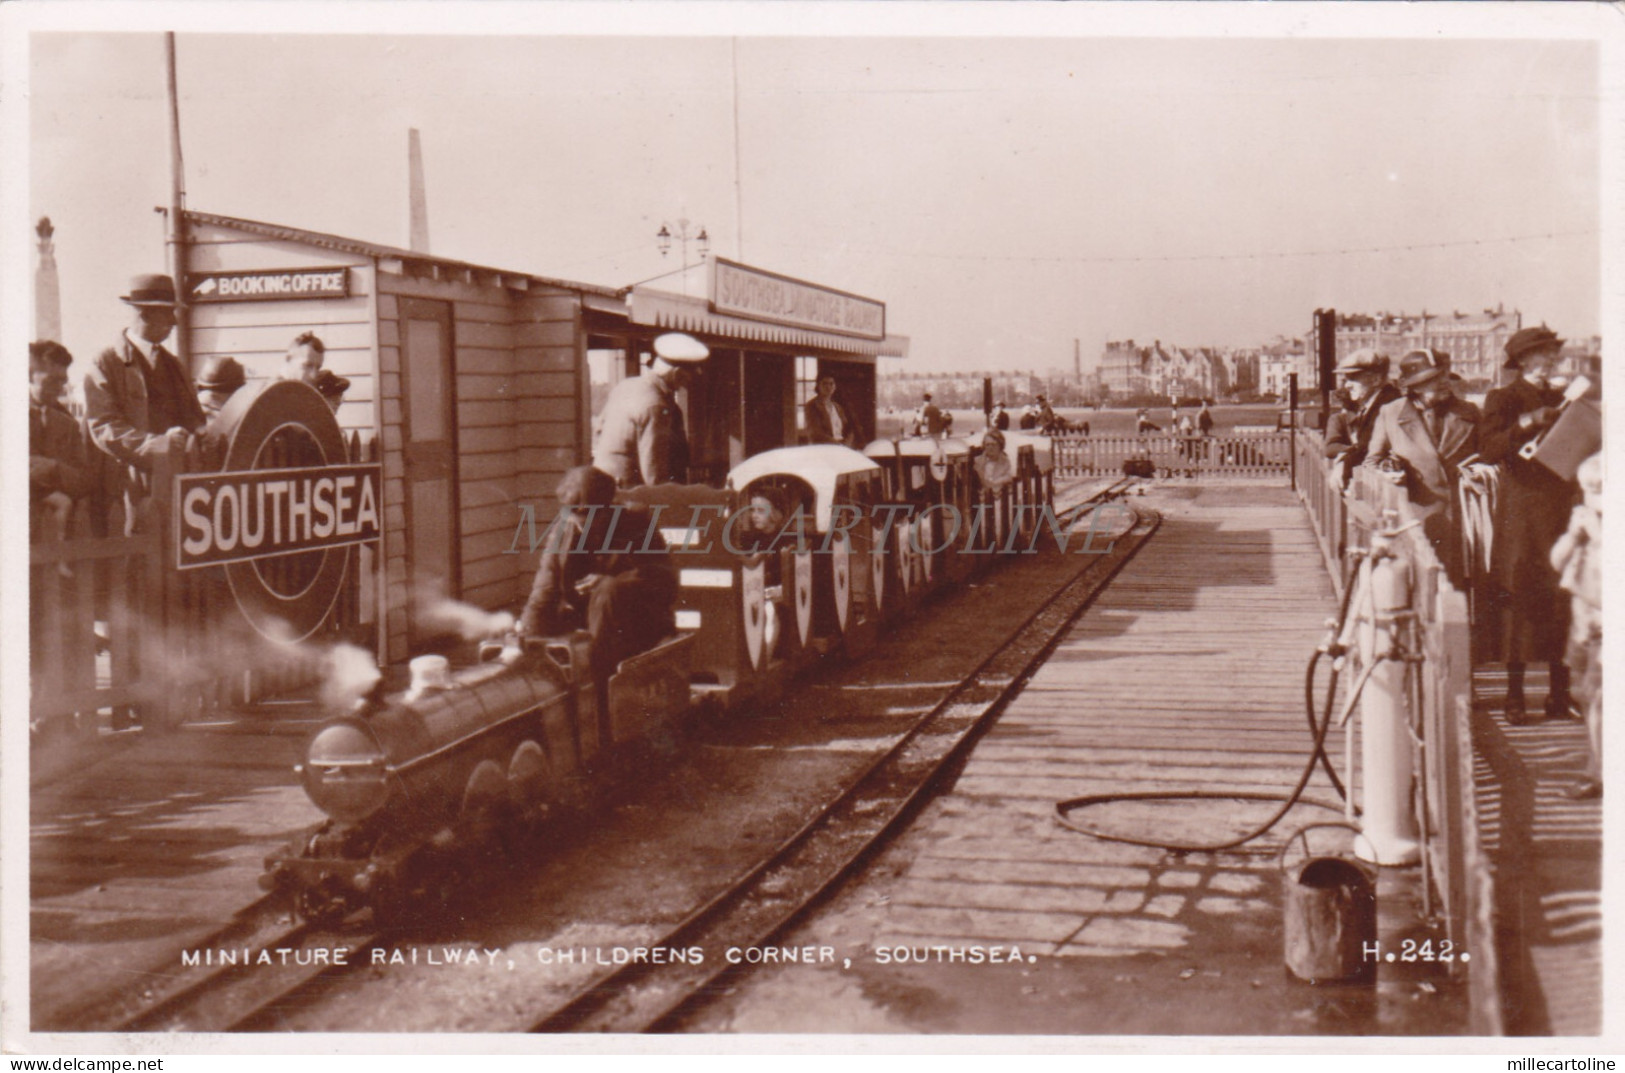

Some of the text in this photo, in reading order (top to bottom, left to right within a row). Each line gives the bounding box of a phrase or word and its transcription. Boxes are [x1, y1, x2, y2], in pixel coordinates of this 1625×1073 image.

[218, 273, 343, 295] BOOKING OFFICE
[183, 475, 379, 555] SOUTHSEA
